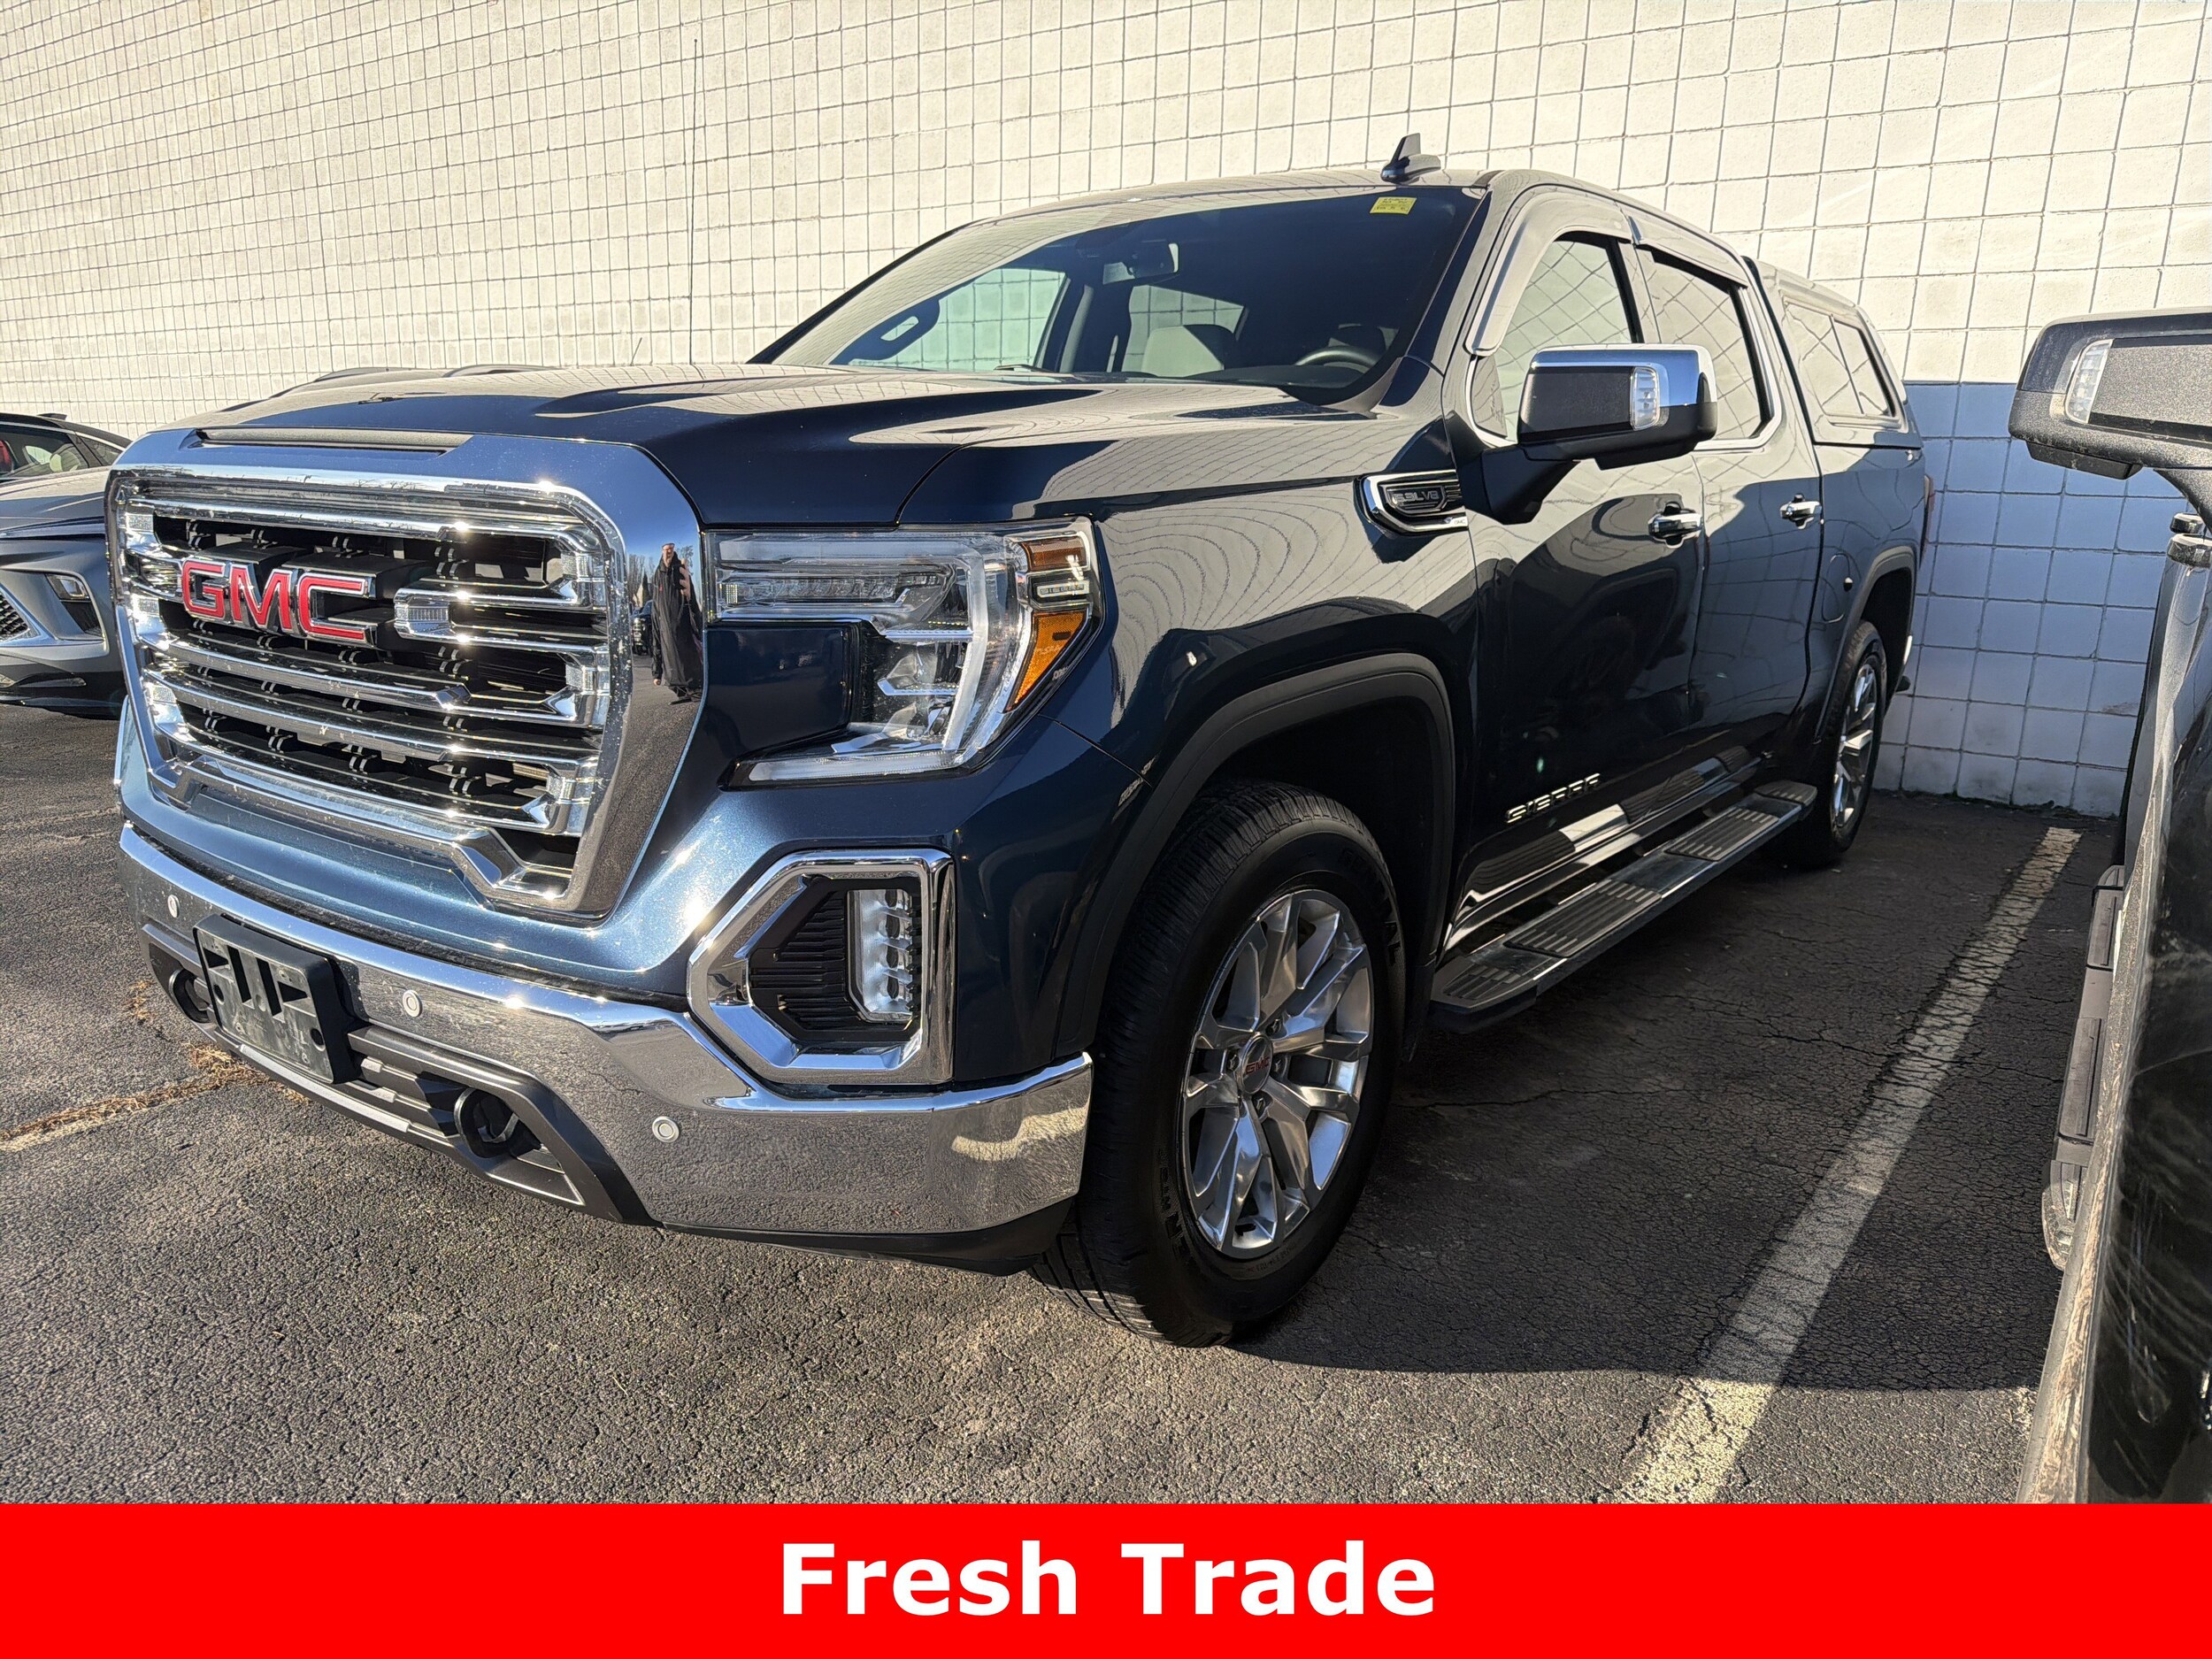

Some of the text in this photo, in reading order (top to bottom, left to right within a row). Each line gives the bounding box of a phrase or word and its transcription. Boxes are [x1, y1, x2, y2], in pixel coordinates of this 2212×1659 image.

[182, 559, 378, 648] GMC
[1505, 772, 1601, 824] SIERRA
[1246, 1056, 1271, 1075] GMC
